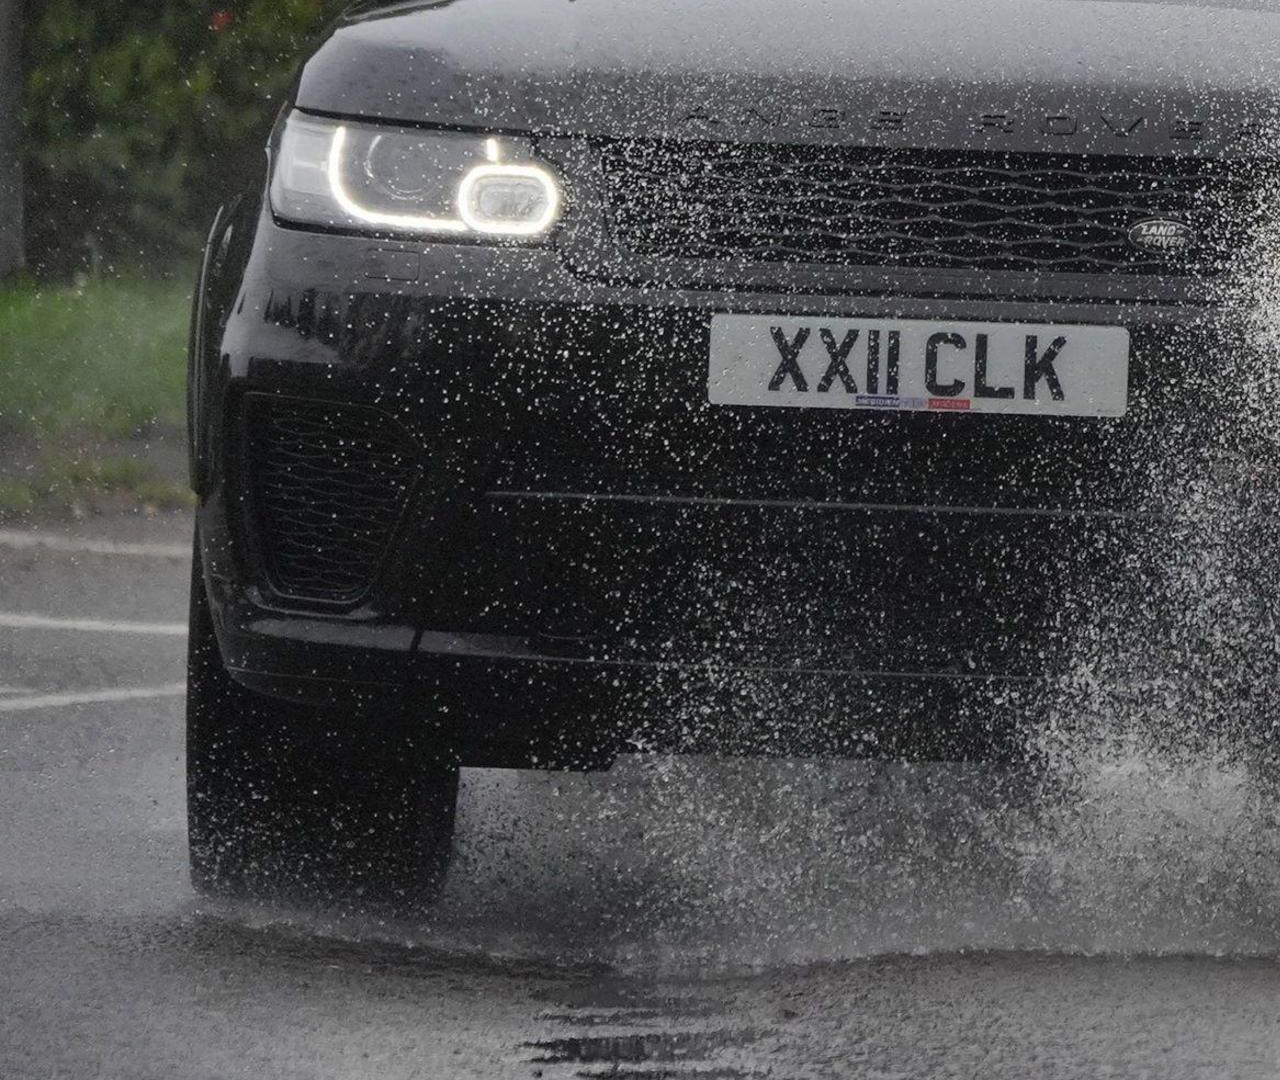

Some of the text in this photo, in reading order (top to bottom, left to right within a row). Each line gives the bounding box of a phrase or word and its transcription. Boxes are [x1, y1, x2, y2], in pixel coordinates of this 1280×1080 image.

[1141, 225, 1176, 236] LAND
[1143, 236, 1186, 249] ROVER
[925, 332, 1067, 401] CLK
